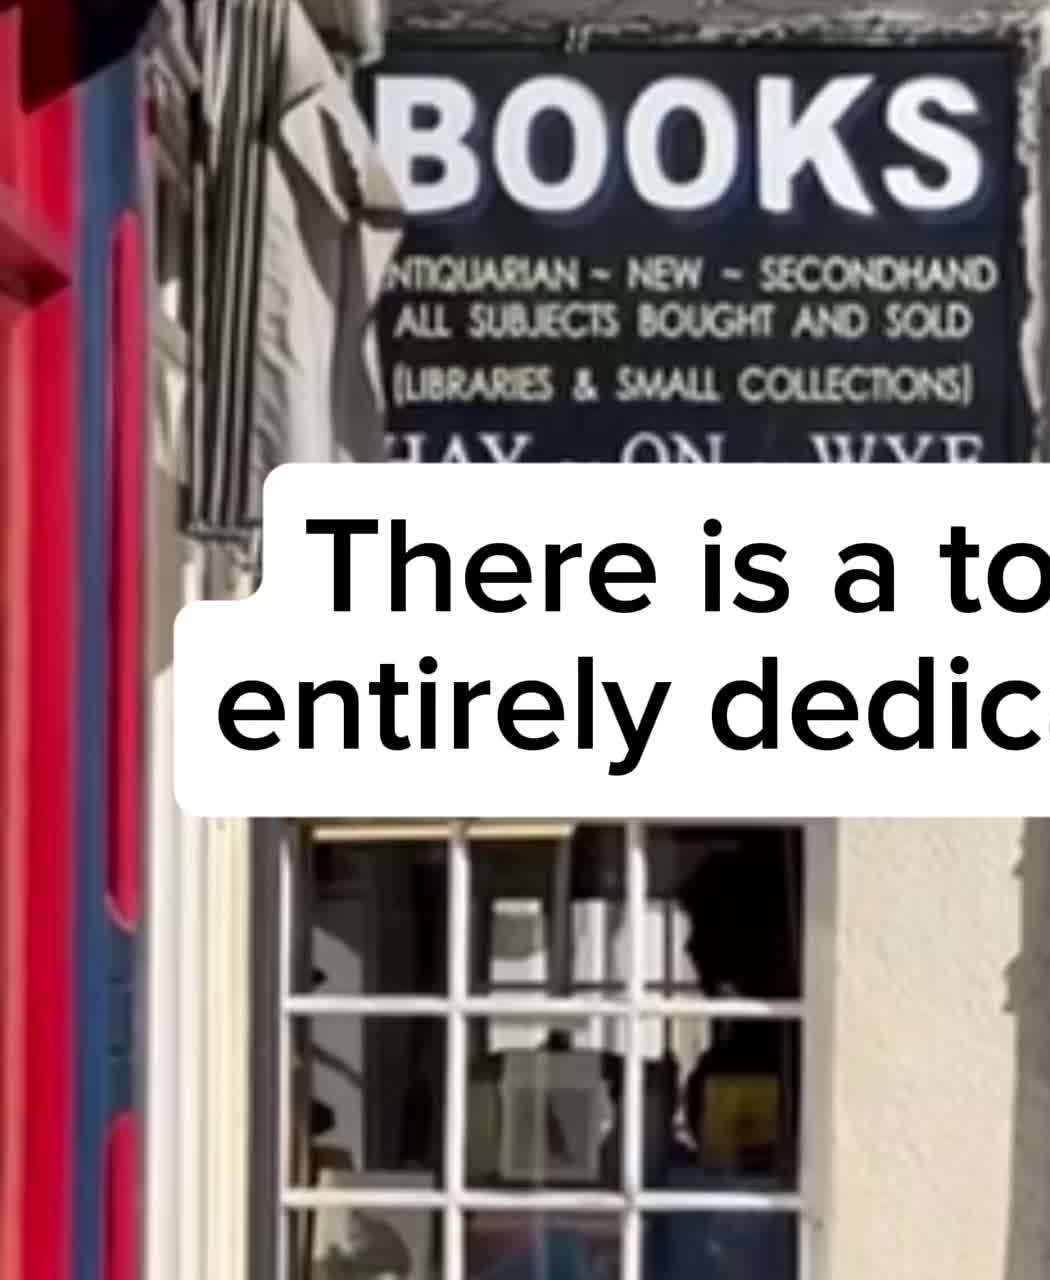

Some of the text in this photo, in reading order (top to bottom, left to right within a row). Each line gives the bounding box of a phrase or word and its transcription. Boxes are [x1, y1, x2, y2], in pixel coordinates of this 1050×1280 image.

[375, 74, 983, 216] BOOKS
[386, 255, 579, 292] NTIQUARIAN
[627, 256, 703, 292] NEW
[760, 254, 999, 292] SECONDHAND
[394, 302, 974, 339] ALL SUBJECTS BOUGHT AND SOLD
[393, 362, 973, 405] (LIBRARIES & SMALL COLLECTIONS)
